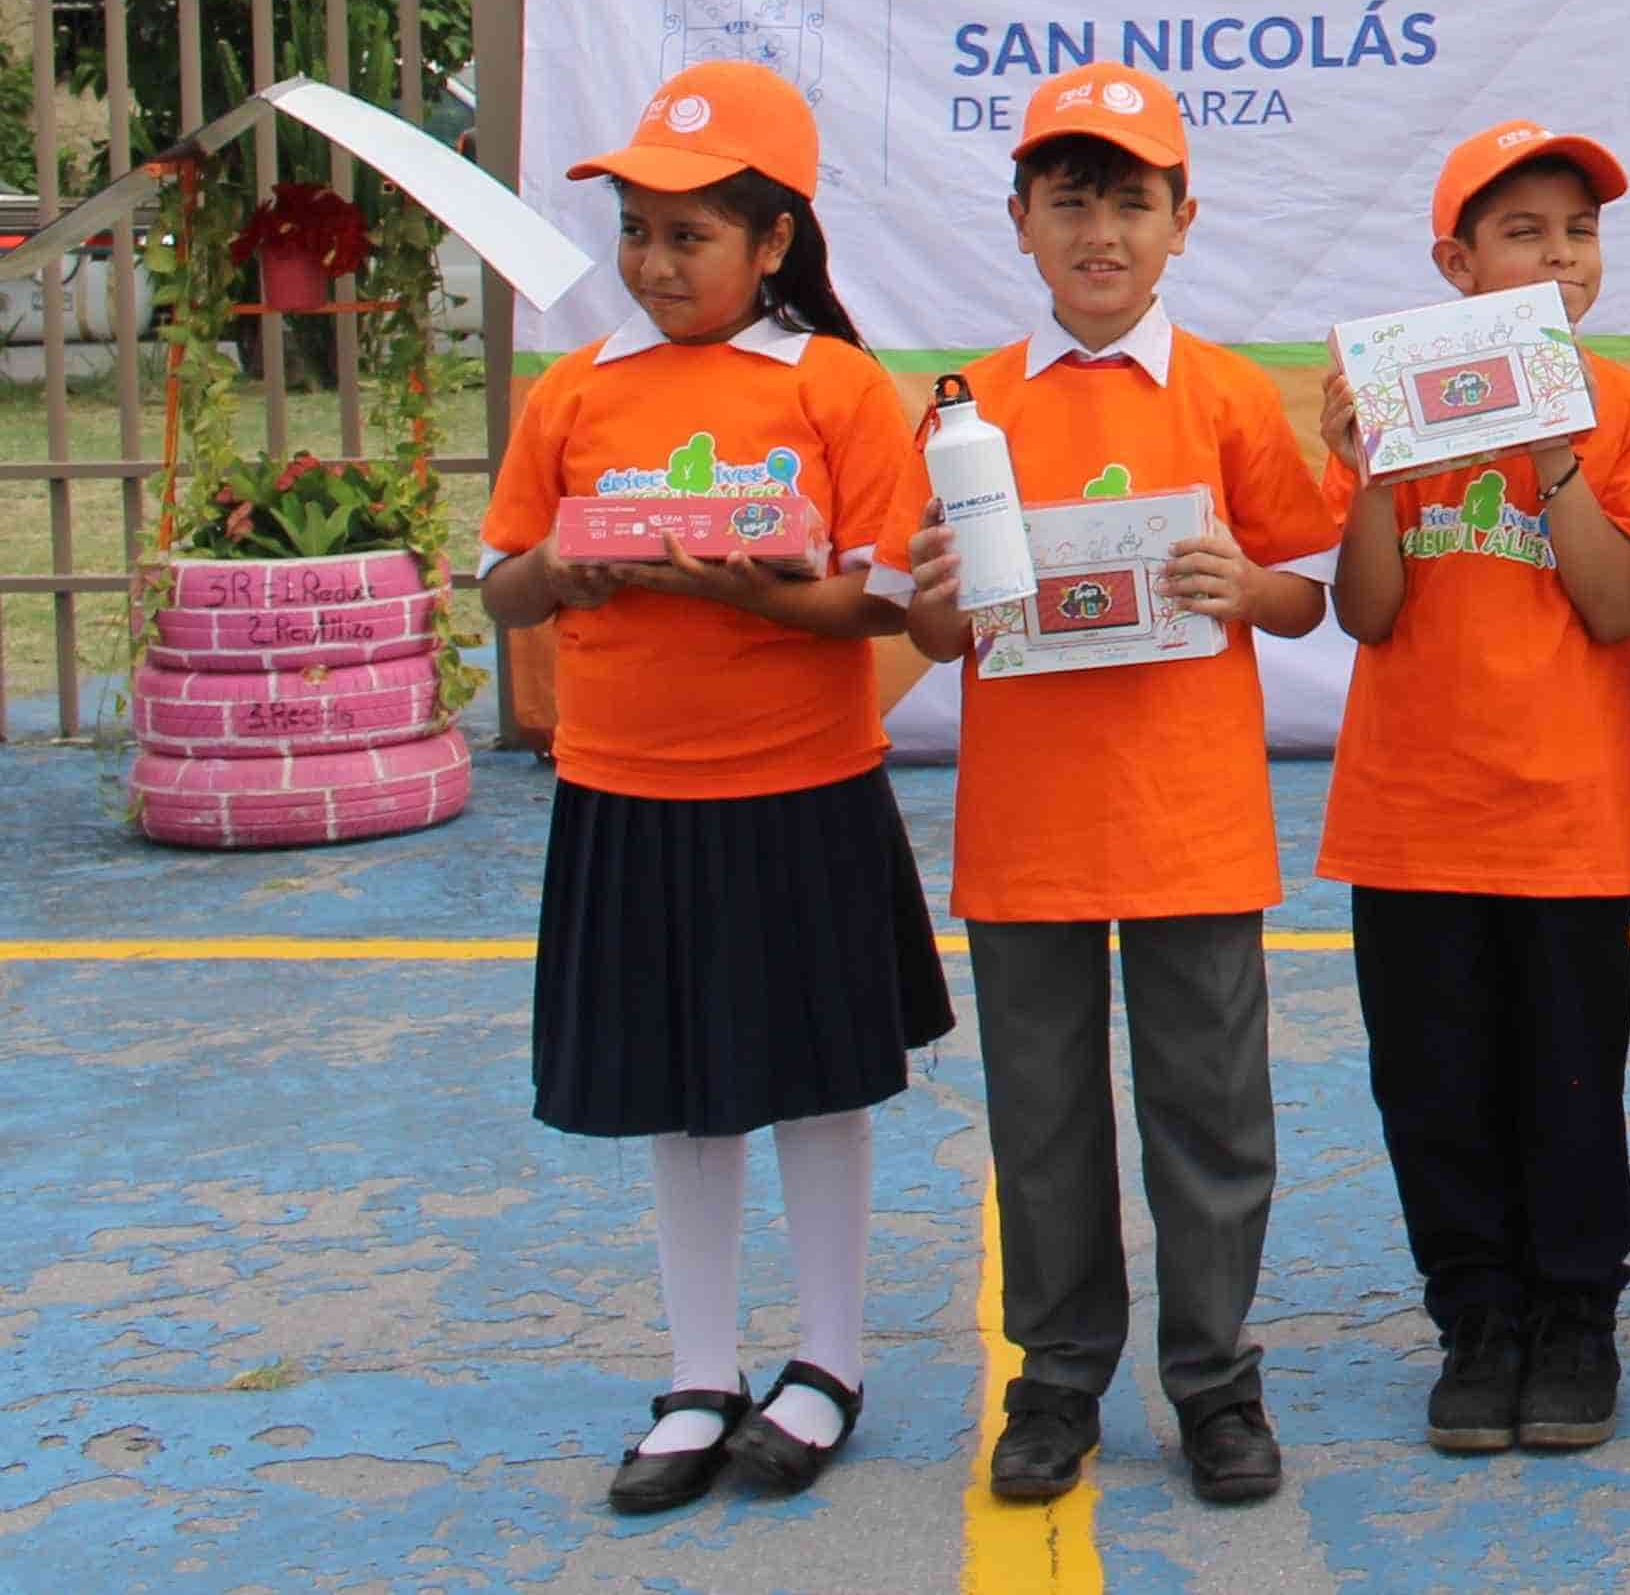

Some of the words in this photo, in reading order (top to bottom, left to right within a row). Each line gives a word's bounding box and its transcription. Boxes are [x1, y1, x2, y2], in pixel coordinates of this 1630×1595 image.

[953, 20, 1095, 77] SAN
[951, 94, 1012, 132] DE
[1174, 89, 1294, 128] ARZA
